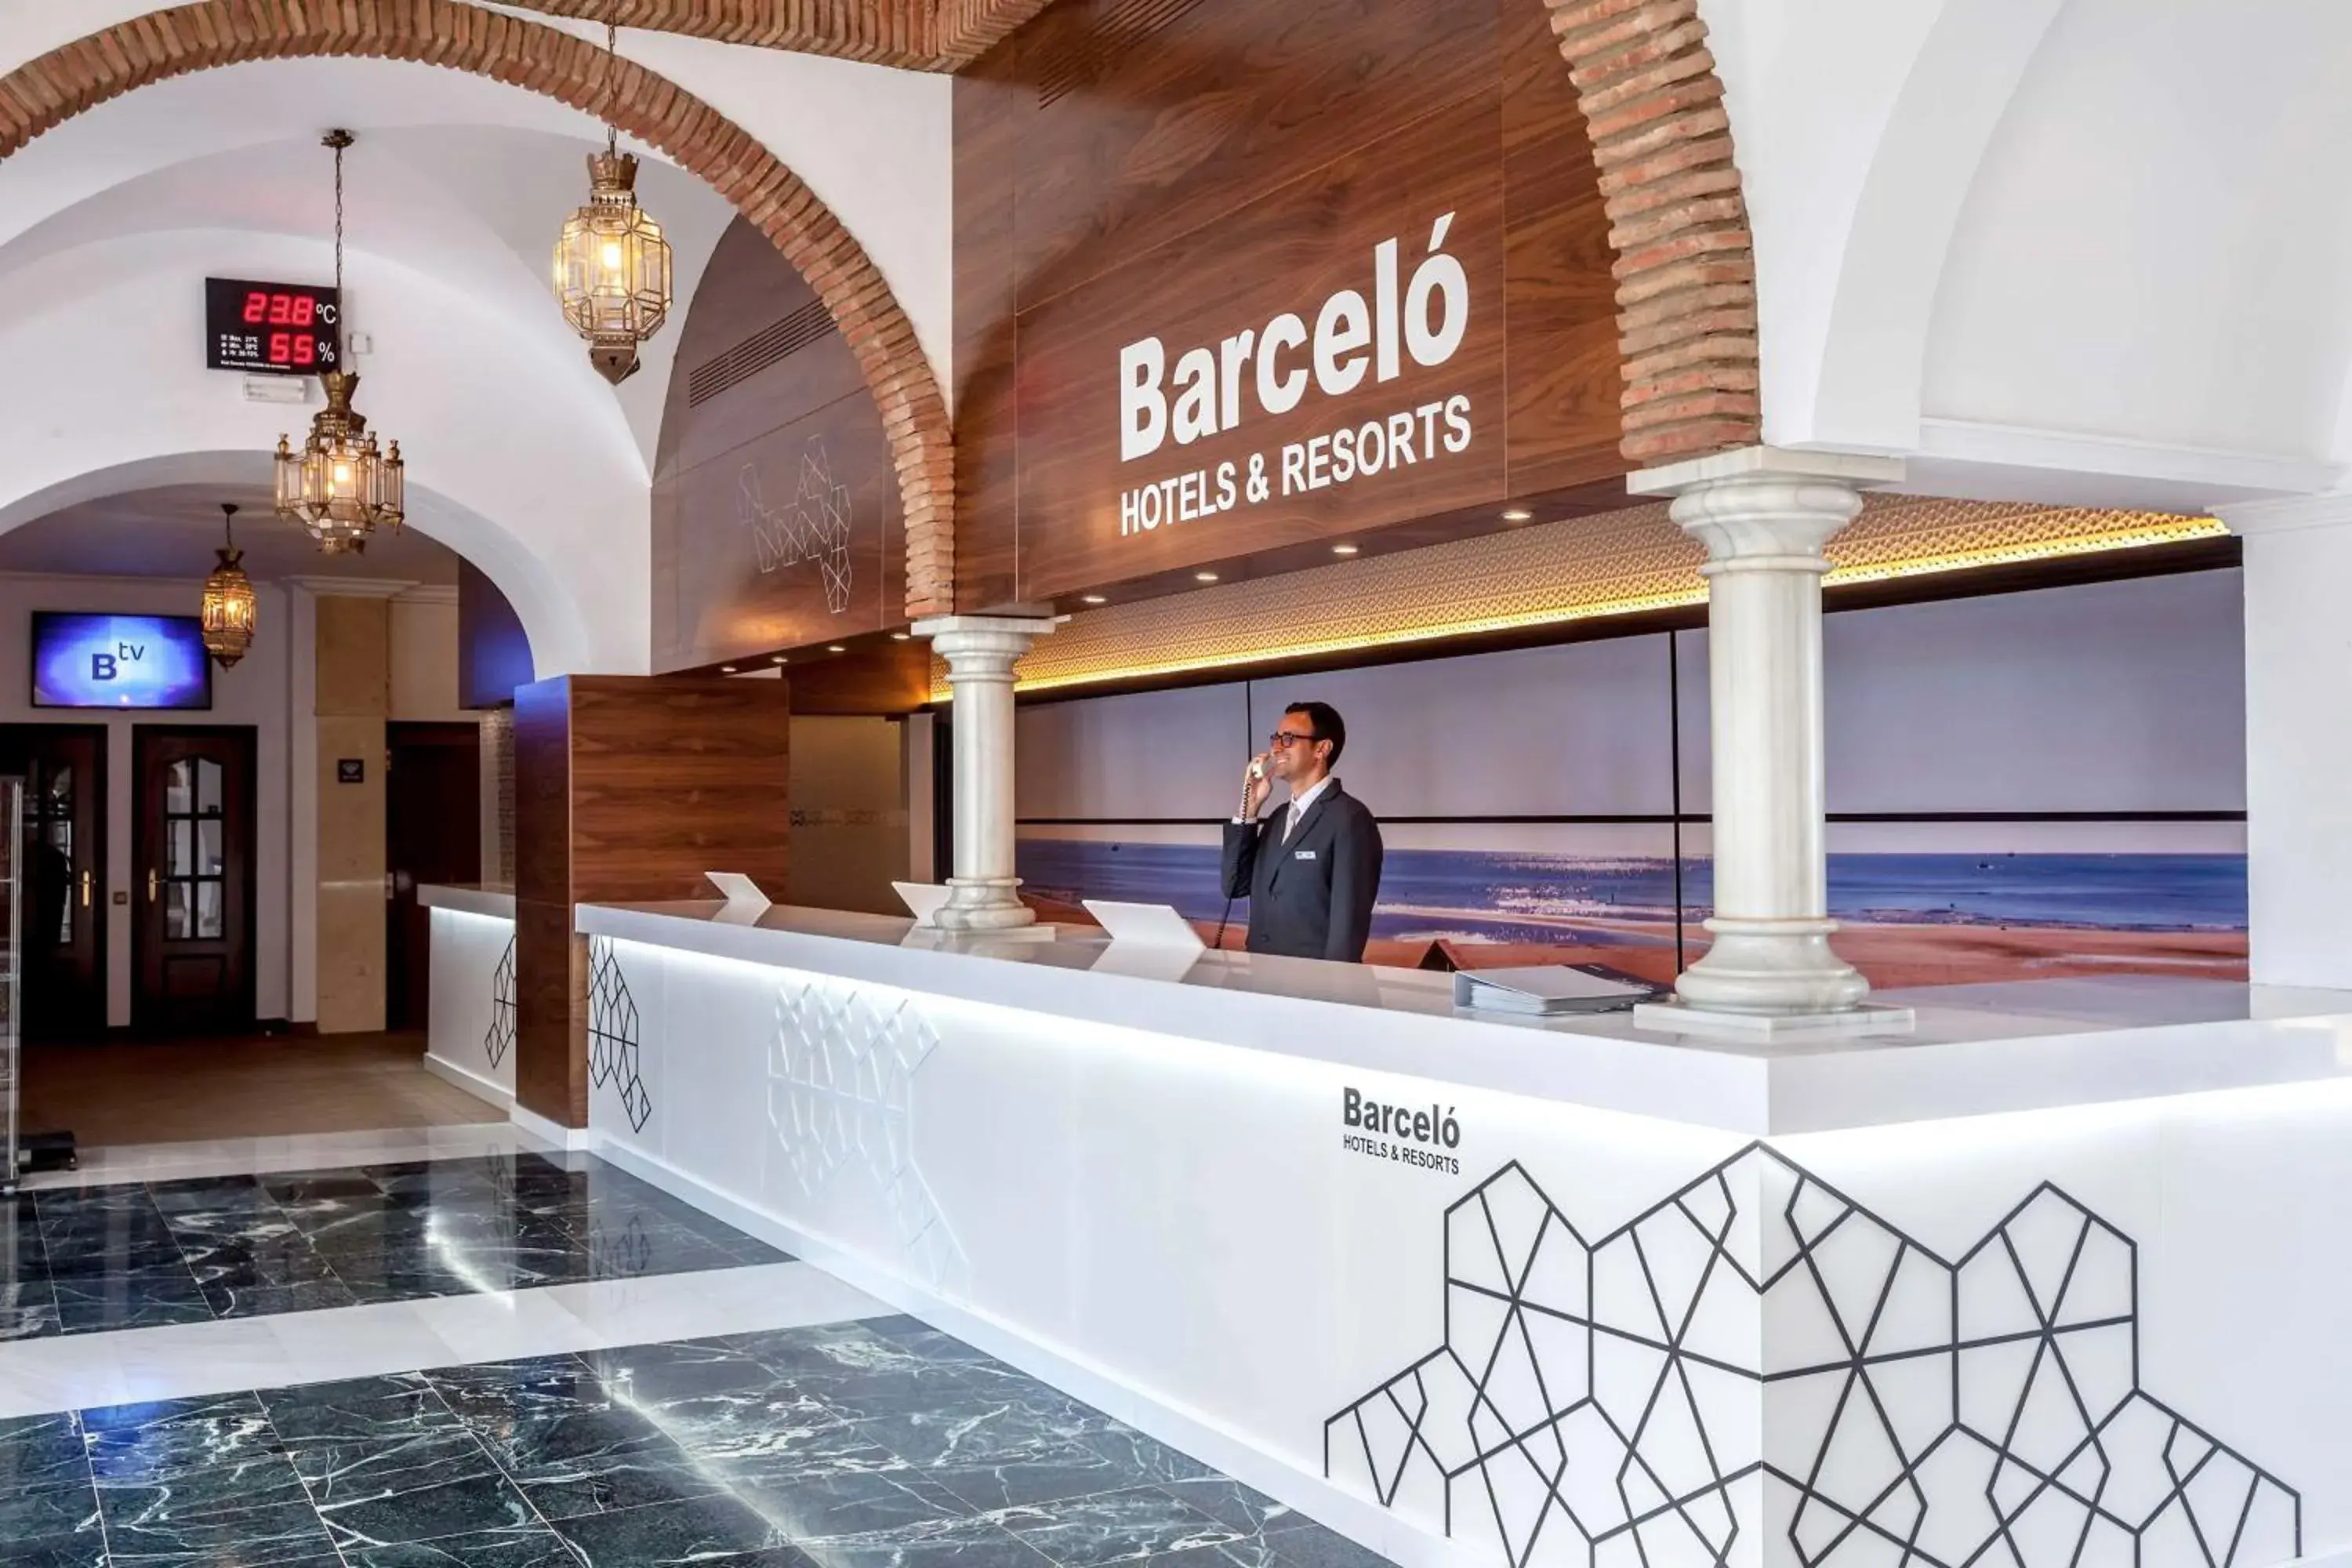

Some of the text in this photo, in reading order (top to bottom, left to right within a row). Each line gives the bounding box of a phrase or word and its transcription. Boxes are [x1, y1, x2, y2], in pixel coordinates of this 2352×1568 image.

[270, 333, 335, 363] 55 %
[1120, 211, 1469, 463] Barceló
[1120, 394, 1472, 536] HOTELS & RESORTS
[1343, 1087, 1460, 1149] Barceló
[1343, 1134, 1460, 1175] HOTELS & RESORTS
